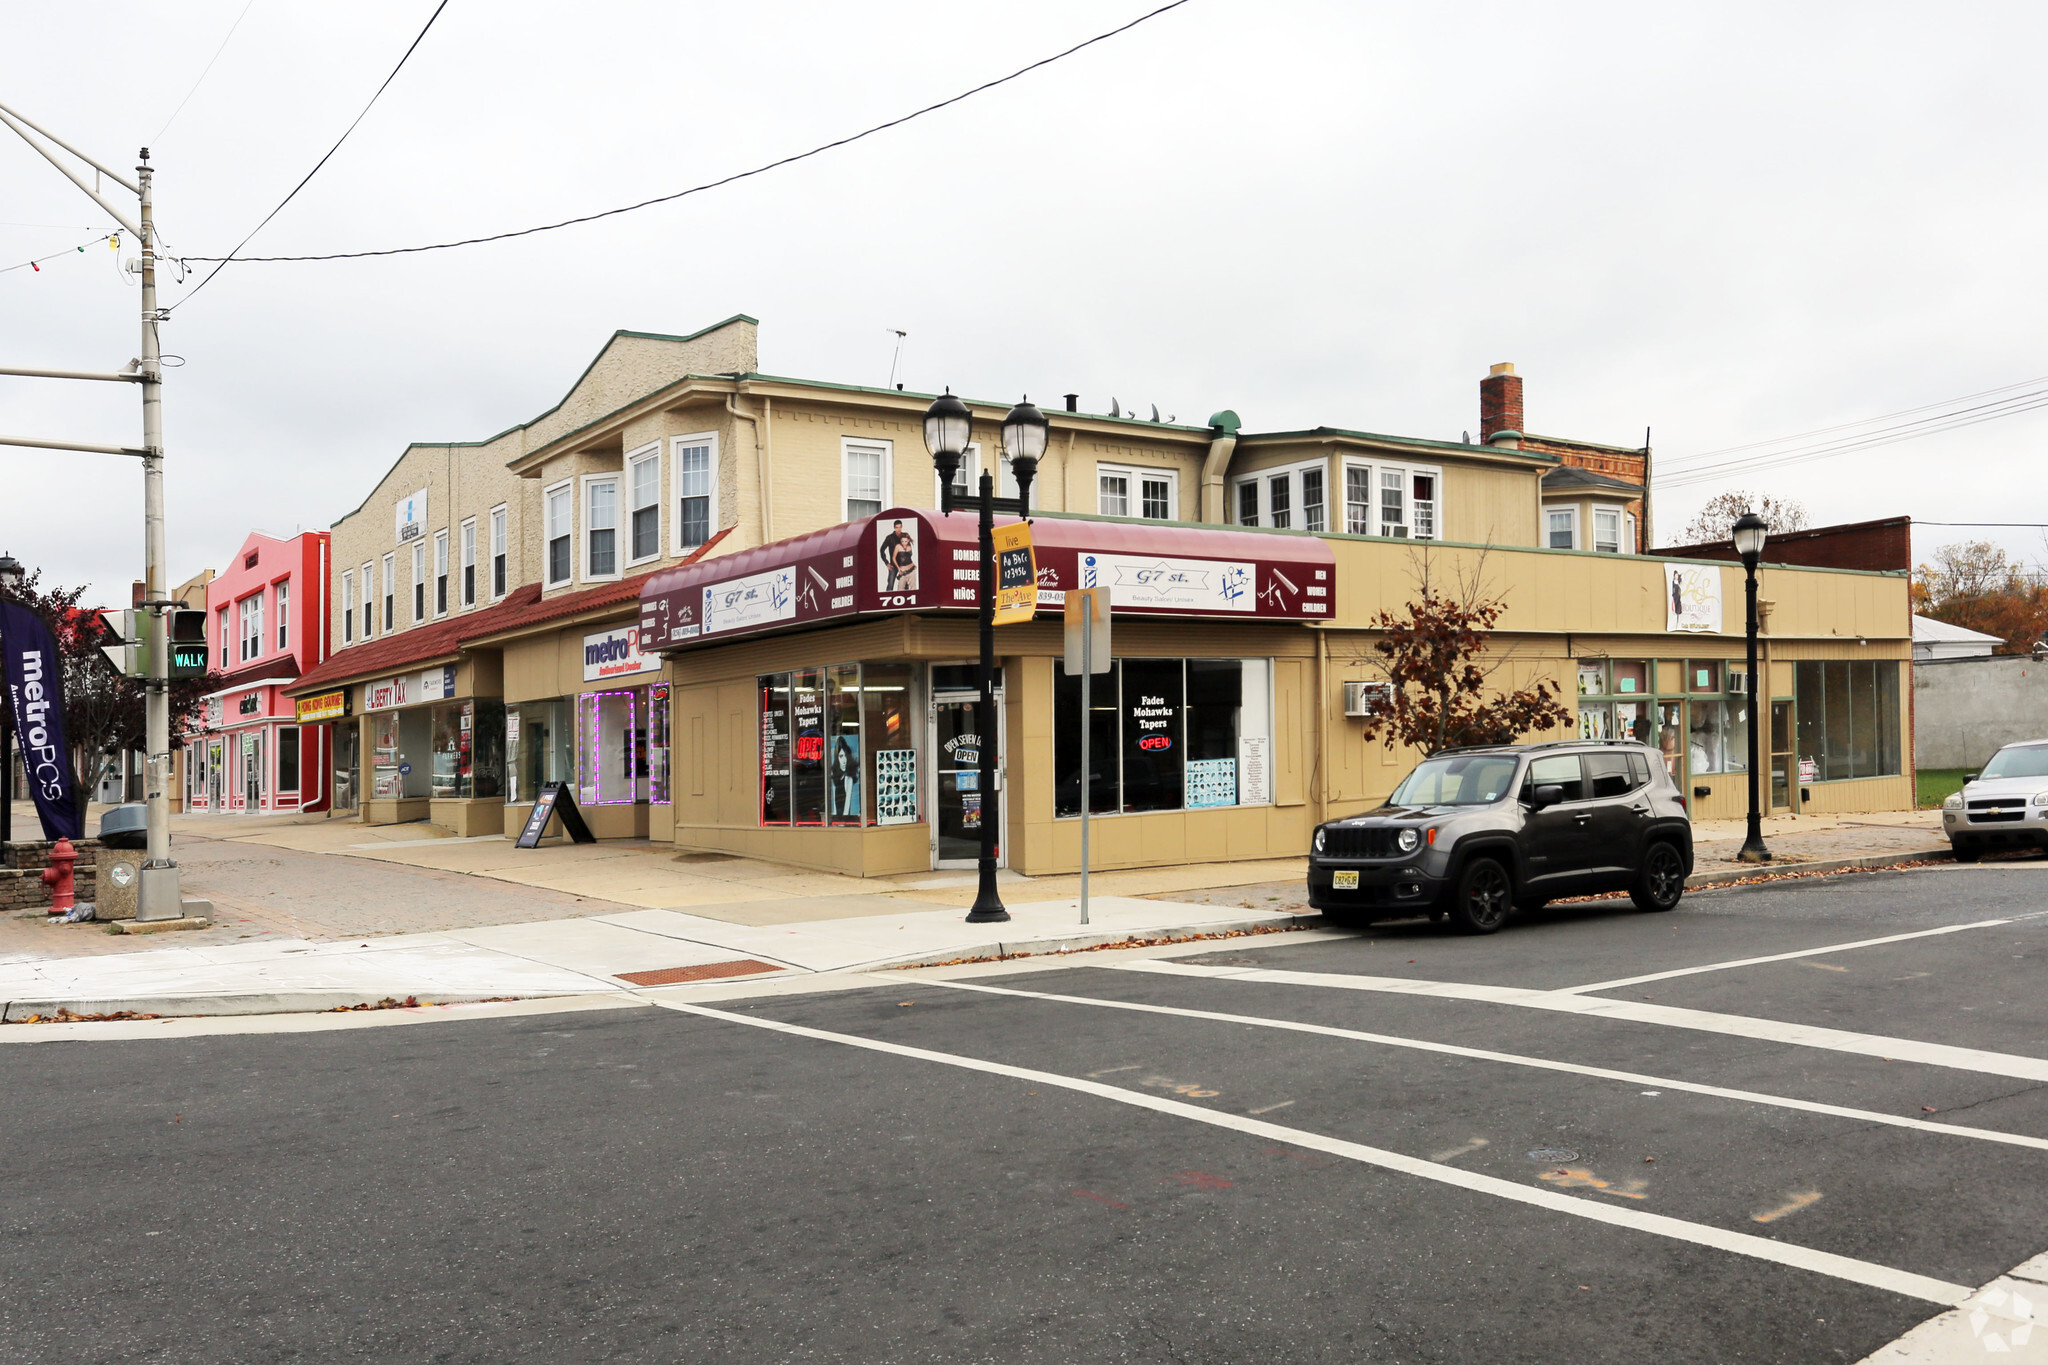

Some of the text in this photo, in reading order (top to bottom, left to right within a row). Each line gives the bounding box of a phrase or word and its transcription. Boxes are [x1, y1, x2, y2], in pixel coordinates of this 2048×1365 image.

[1006, 536, 1018, 546] live
[953, 549, 980, 561] HOMBR
[843, 556, 853, 568] MEN
[953, 569, 980, 580] MUJERE
[1036, 567, 1059, 580] alk-Ins
[1137, 570, 1189, 584] G7 st.
[1315, 570, 1326, 580] MEN
[836, 575, 853, 589] WOMEN
[1036, 576, 1058, 587] elcome
[953, 587, 975, 600] NIÑOS
[1307, 586, 1326, 596] WOMEN
[725, 588, 758, 608] G7 st.
[831, 595, 853, 609] CHILDREN
[879, 595, 917, 607] 701
[1001, 591, 1031, 604] The Ave
[1302, 603, 1326, 613] CHILDREN
[586, 629, 654, 666] metroPC
[175, 653, 204, 667] WALK
[370, 678, 406, 708] LIBERTY TAX
[799, 694, 815, 703] Fades
[1141, 696, 1164, 705] Fades
[795, 705, 822, 716] Mohawks
[1133, 707, 1173, 717] Mohawks
[22, 650, 62, 800] metroPCS
[798, 717, 818, 727] Tapers
[1139, 720, 1167, 730] Tapers
[797, 737, 823, 760] OPEN
[944, 737, 959, 753] OPEN
[958, 734, 976, 745] SEVEN
[1140, 737, 1169, 750] OPEN
[956, 750, 977, 761] OPEN
